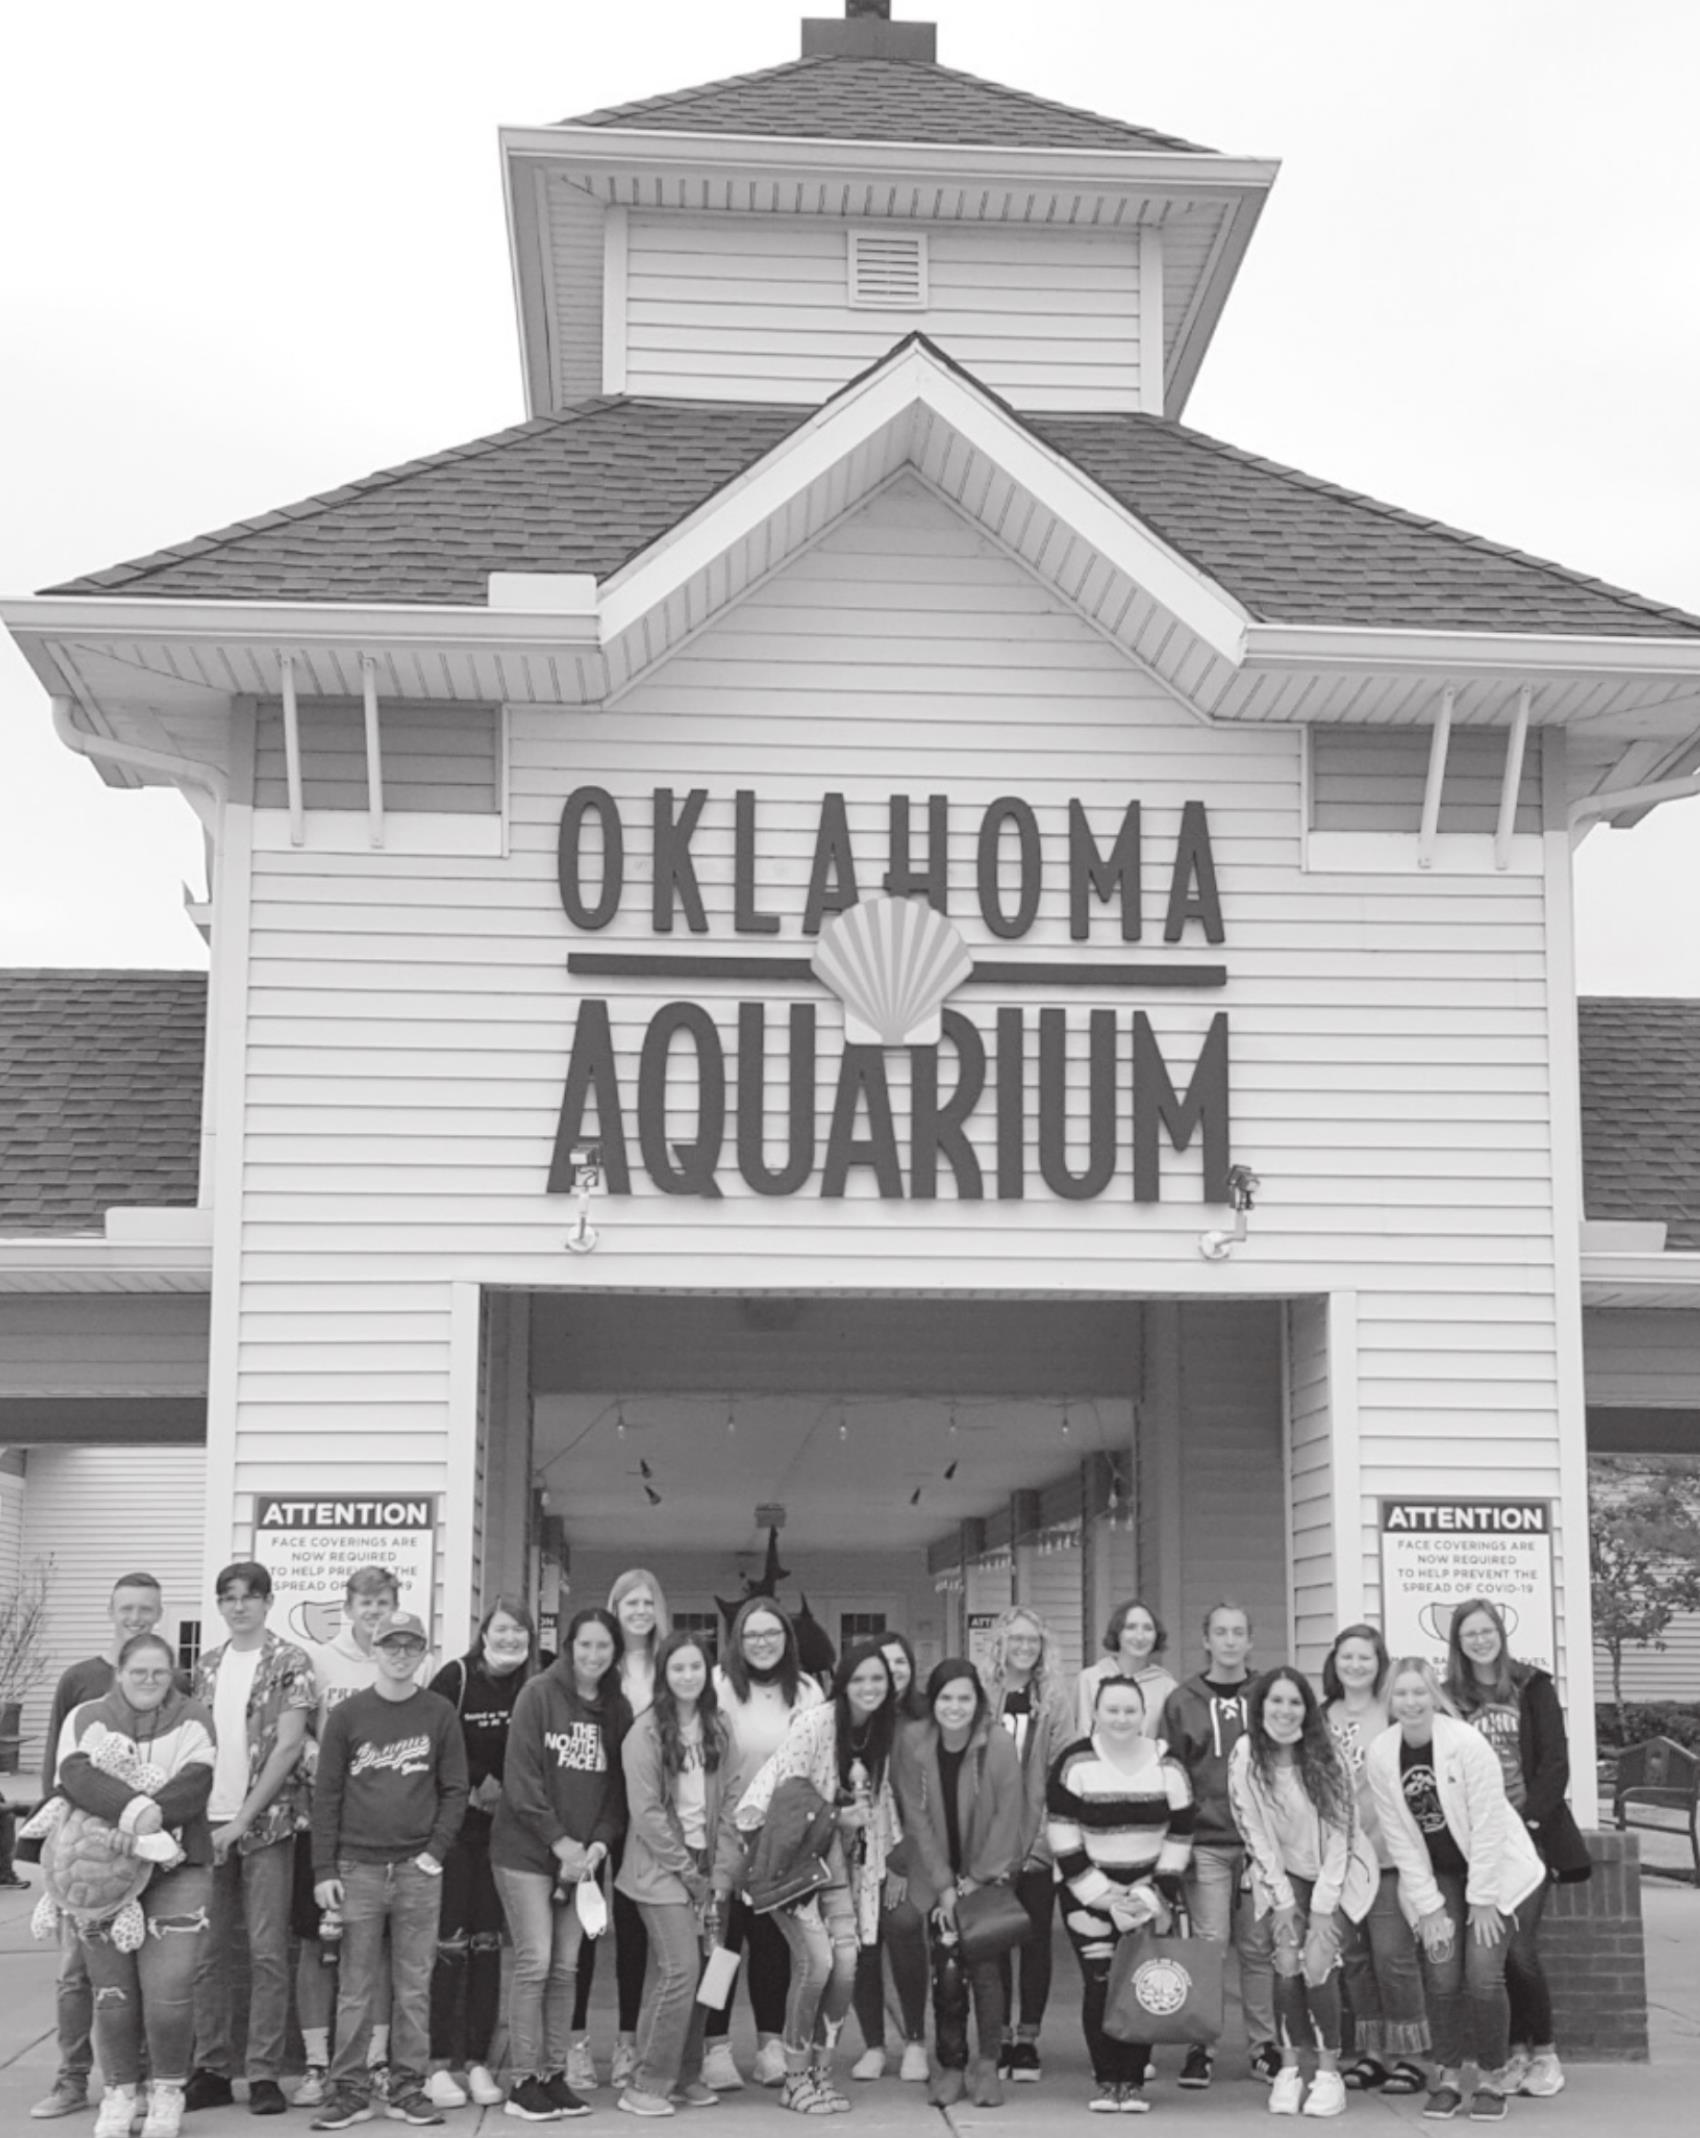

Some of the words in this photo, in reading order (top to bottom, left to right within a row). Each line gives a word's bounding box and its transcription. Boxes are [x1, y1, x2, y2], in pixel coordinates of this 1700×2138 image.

[558, 785, 1226, 944] OKLAHOMA
[546, 999, 1232, 1203] AQUARIUM
[262, 1502, 428, 1526] ATTENTION
[1387, 1506, 1543, 1530] ATTENTION
[271, 1536, 307, 1548] FACE
[310, 1536, 388, 1548] COVERINGS
[391, 1536, 418, 1548] ARE
[1397, 1539, 1431, 1551] FACE
[1433, 1540, 1507, 1551] COVERINGS
[1510, 1541, 1535, 1552] ARE
[291, 1551, 325, 1562] NOW
[329, 1551, 397, 1562] REQUIRED
[1417, 1554, 1449, 1565] NOW
[1452, 1555, 1517, 1566] REQUIRED
[270, 1566, 288, 1577] TO
[291, 1566, 325, 1577] HELP
[394, 1566, 418, 1577] THE
[1398, 1568, 1415, 1578] TO
[1418, 1568, 1449, 1579] HELP
[1453, 1569, 1509, 1580] PREVENT
[1514, 1569, 1539, 1580] THE
[273, 1580, 327, 1592] SPREAD
[1402, 1583, 1452, 1594] SPREAD
[1455, 1583, 1472, 1593] OF
[1476, 1583, 1535, 1594] COVID-19
[570, 1721, 598, 1738] THE
[545, 1732, 598, 1755] NORTH
[558, 1750, 597, 1771] FACE
